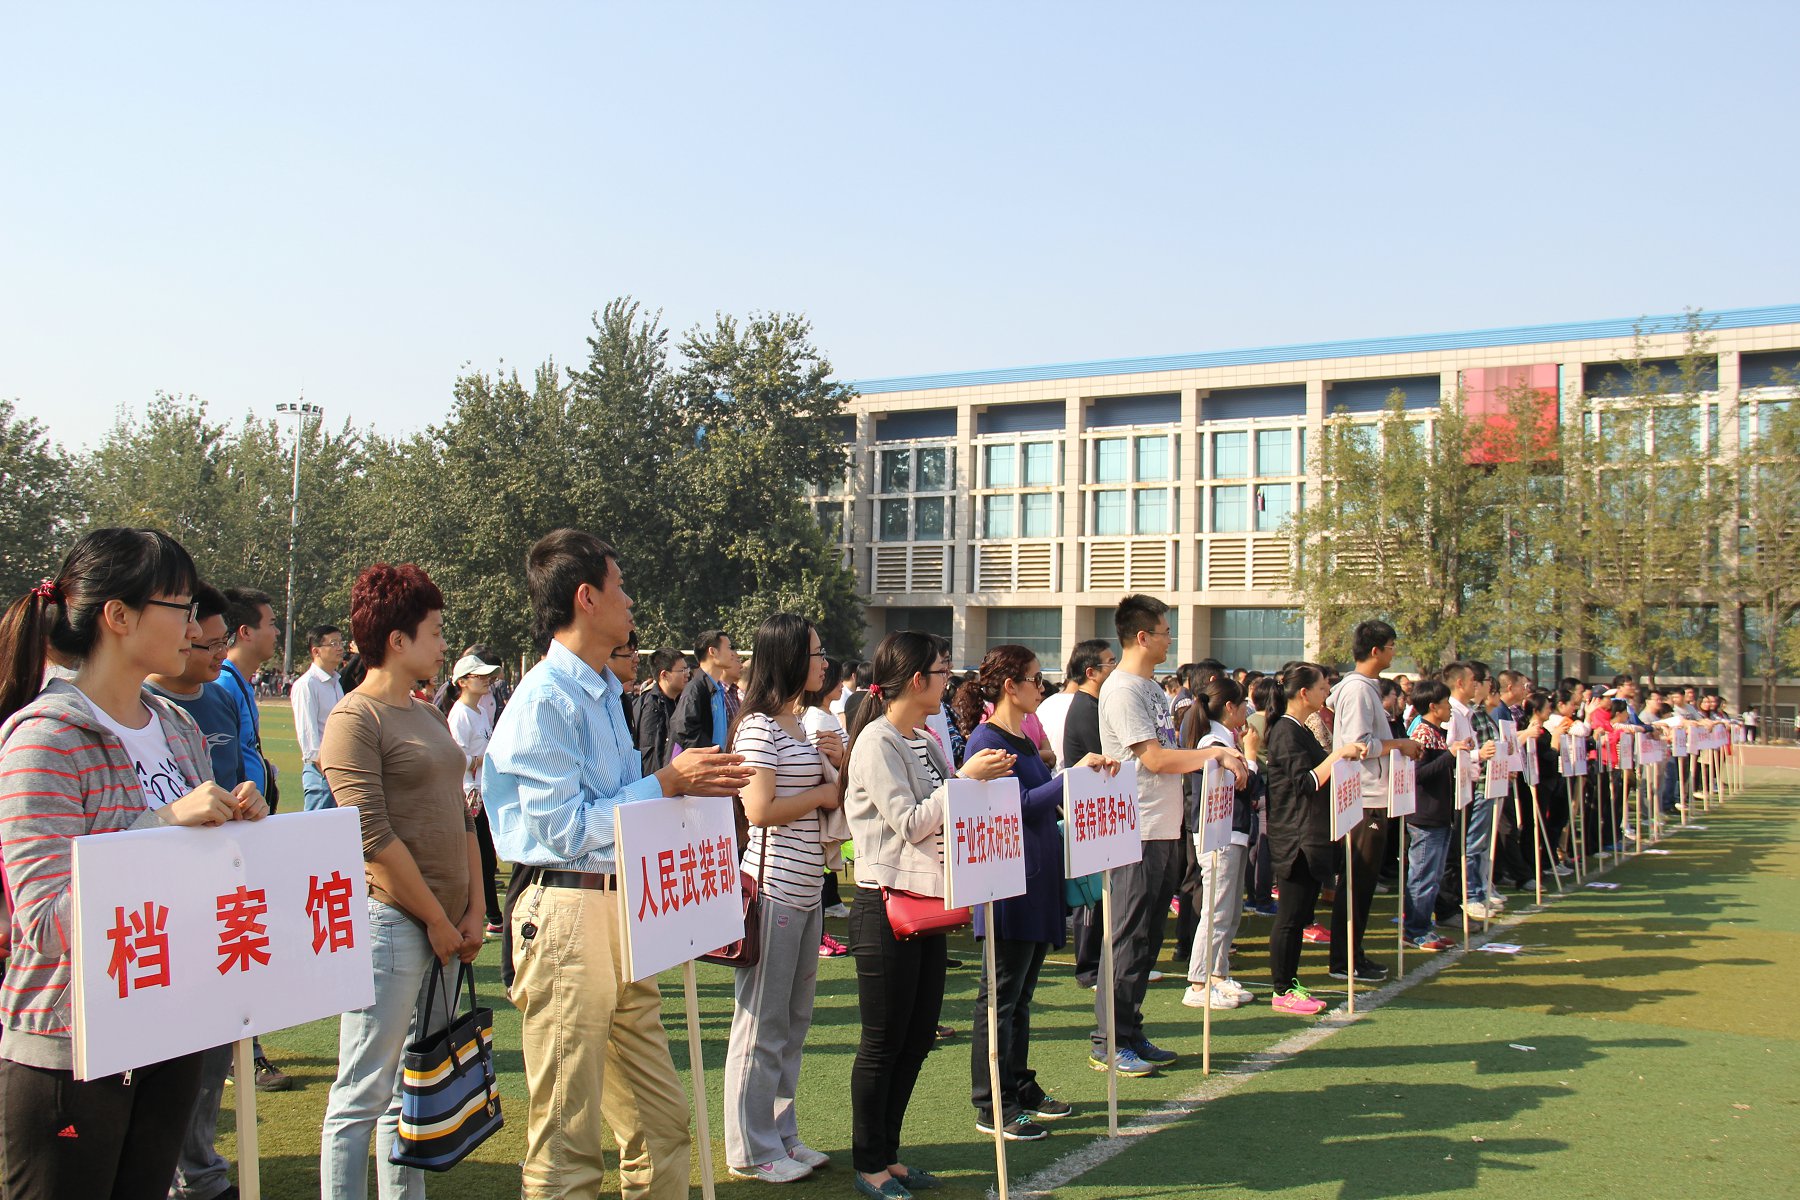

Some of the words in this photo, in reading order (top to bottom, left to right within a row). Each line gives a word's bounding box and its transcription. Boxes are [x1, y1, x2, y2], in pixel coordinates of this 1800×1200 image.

[955, 815, 1022, 866] 产业技术研究院
[1073, 796, 1136, 842] 接待服务中心
[637, 834, 736, 922] 人民武装部
[107, 870, 354, 999] 档案馆
